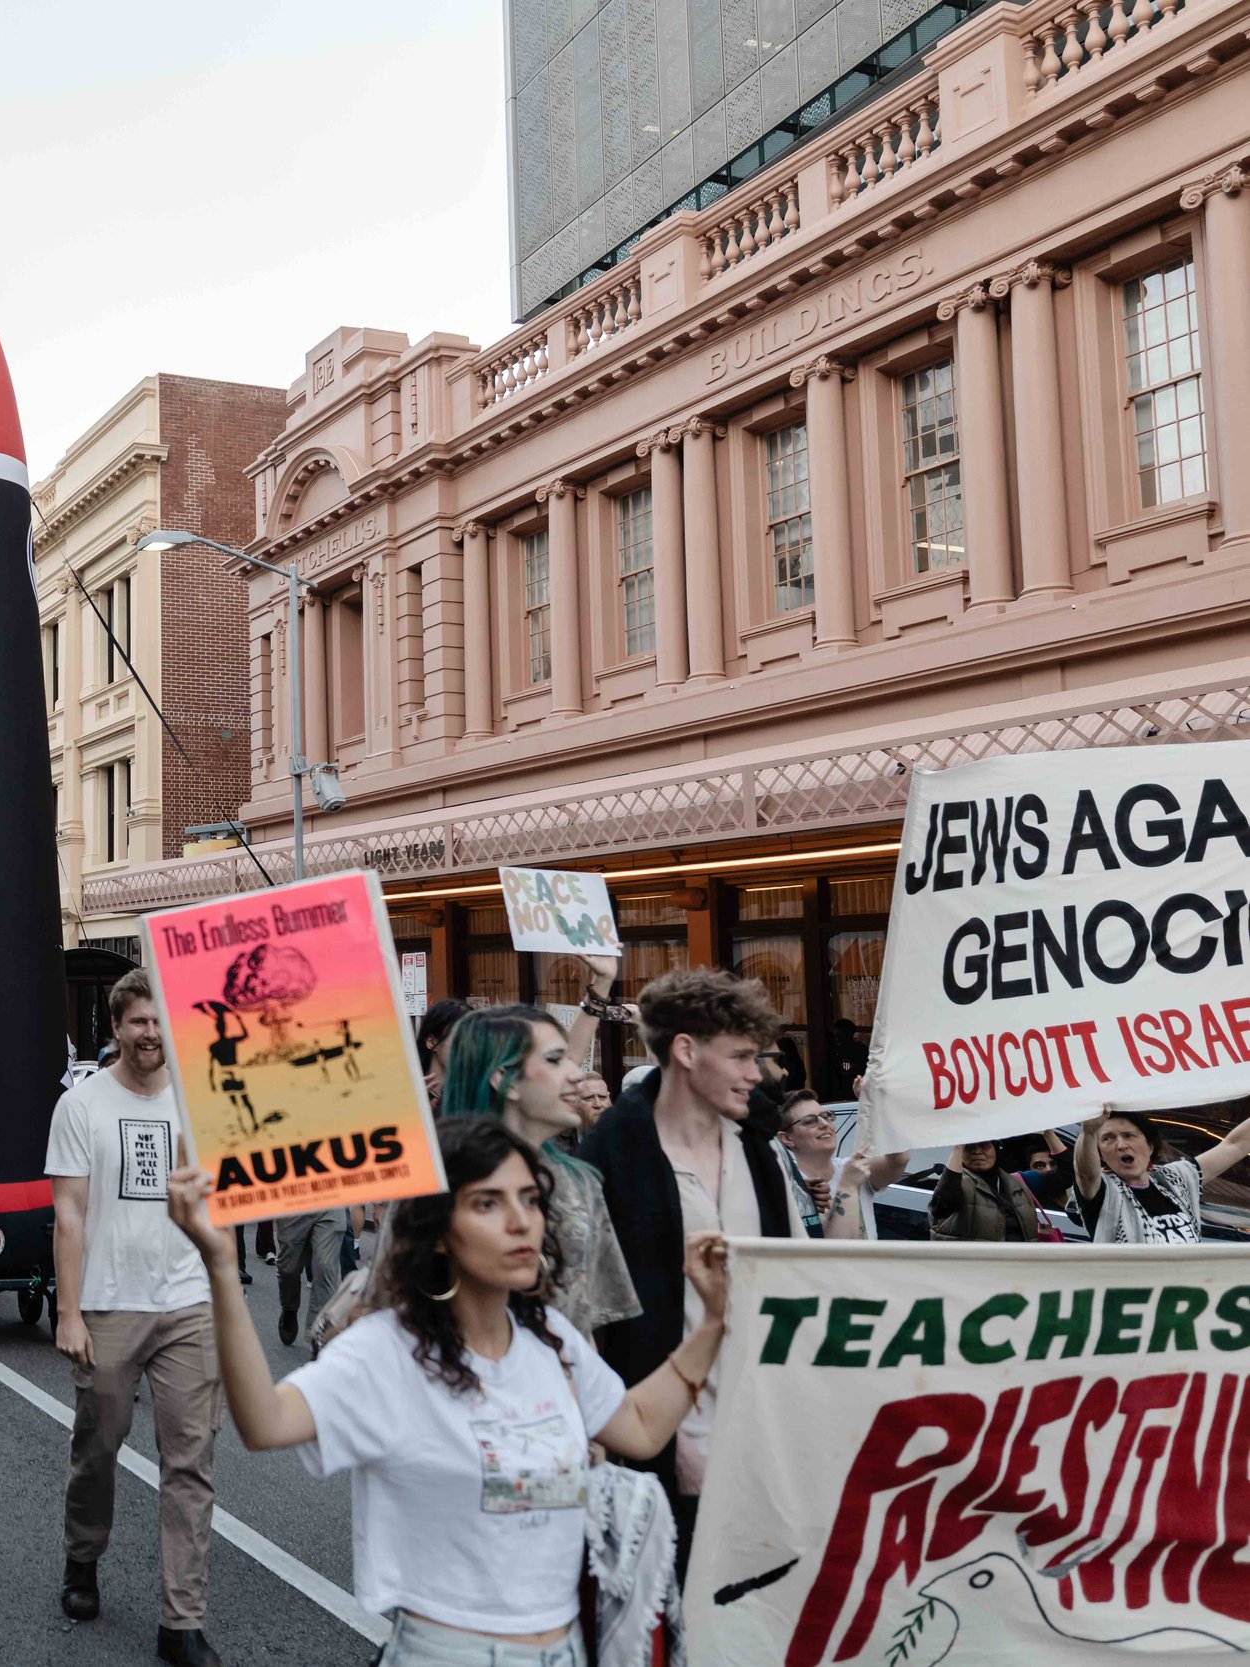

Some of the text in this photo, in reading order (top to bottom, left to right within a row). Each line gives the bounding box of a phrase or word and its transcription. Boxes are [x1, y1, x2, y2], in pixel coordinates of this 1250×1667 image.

[706, 247, 934, 386] BUILDINGS.
[313, 356, 335, 395] 1912
[364, 840, 445, 866] LIGHT YEARS
[905, 793, 1050, 895] JEWS
[503, 870, 588, 905] PEACE
[162, 900, 348, 958] The Endless Bummer
[513, 901, 566, 936] NOT
[556, 912, 617, 948] WAR
[942, 889, 1250, 1005] GENOCI
[922, 1021, 1111, 1110] BOYCOTT
[135, 1142, 155, 1150] FREE
[138, 1134, 153, 1142] NOT
[140, 1168, 156, 1176] ALL
[216, 1126, 404, 1193] AUKUS
[136, 1177, 158, 1187] FREE
[759, 1284, 1250, 1368] TEACHERS
